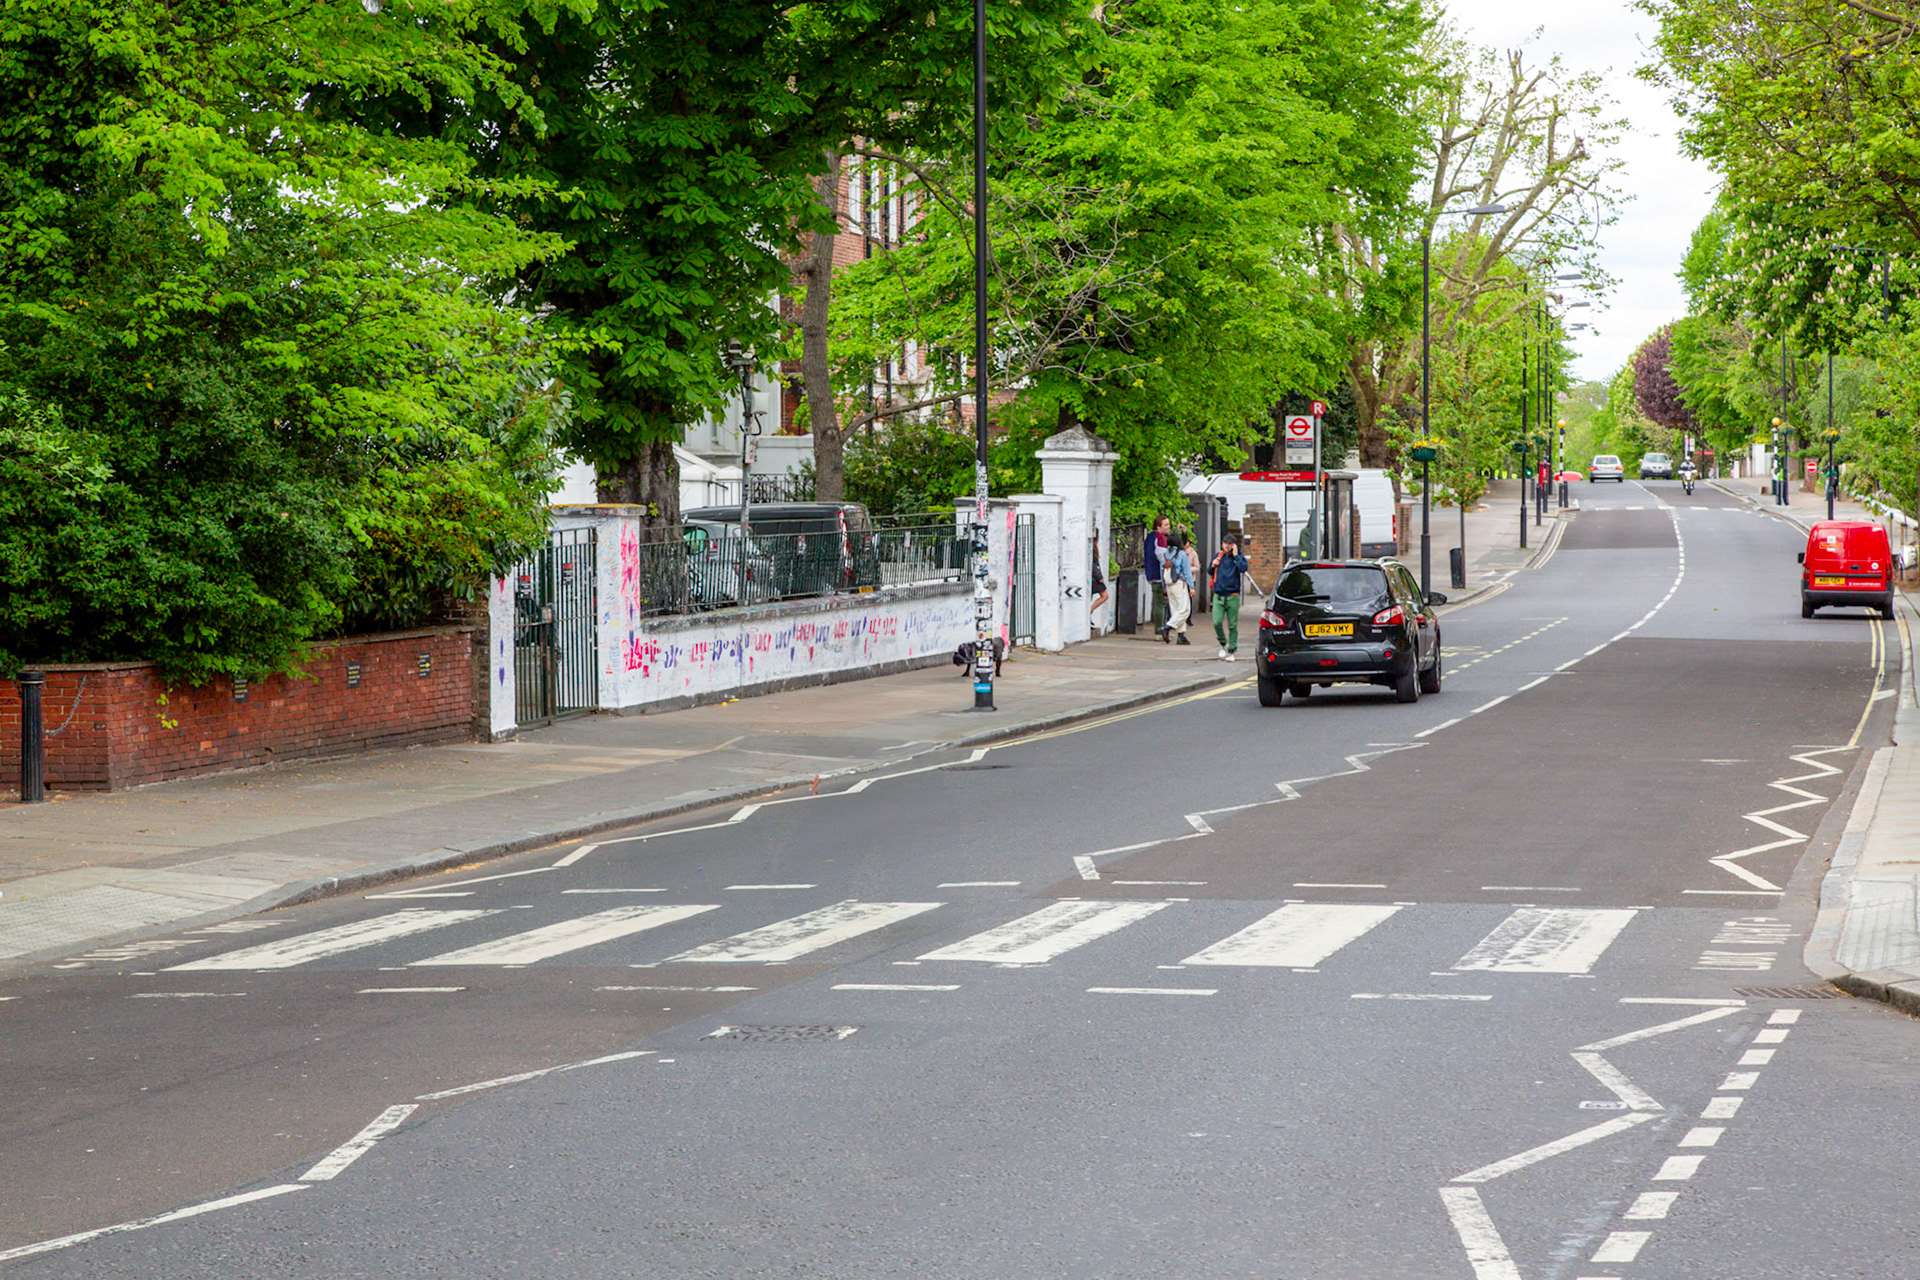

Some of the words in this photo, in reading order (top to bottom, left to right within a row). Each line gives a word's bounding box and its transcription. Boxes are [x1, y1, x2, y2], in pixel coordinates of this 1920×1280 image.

[1313, 402, 1323, 415] R
[1309, 625, 1331, 634] EJ62
[1333, 624, 1349, 633] VMY
